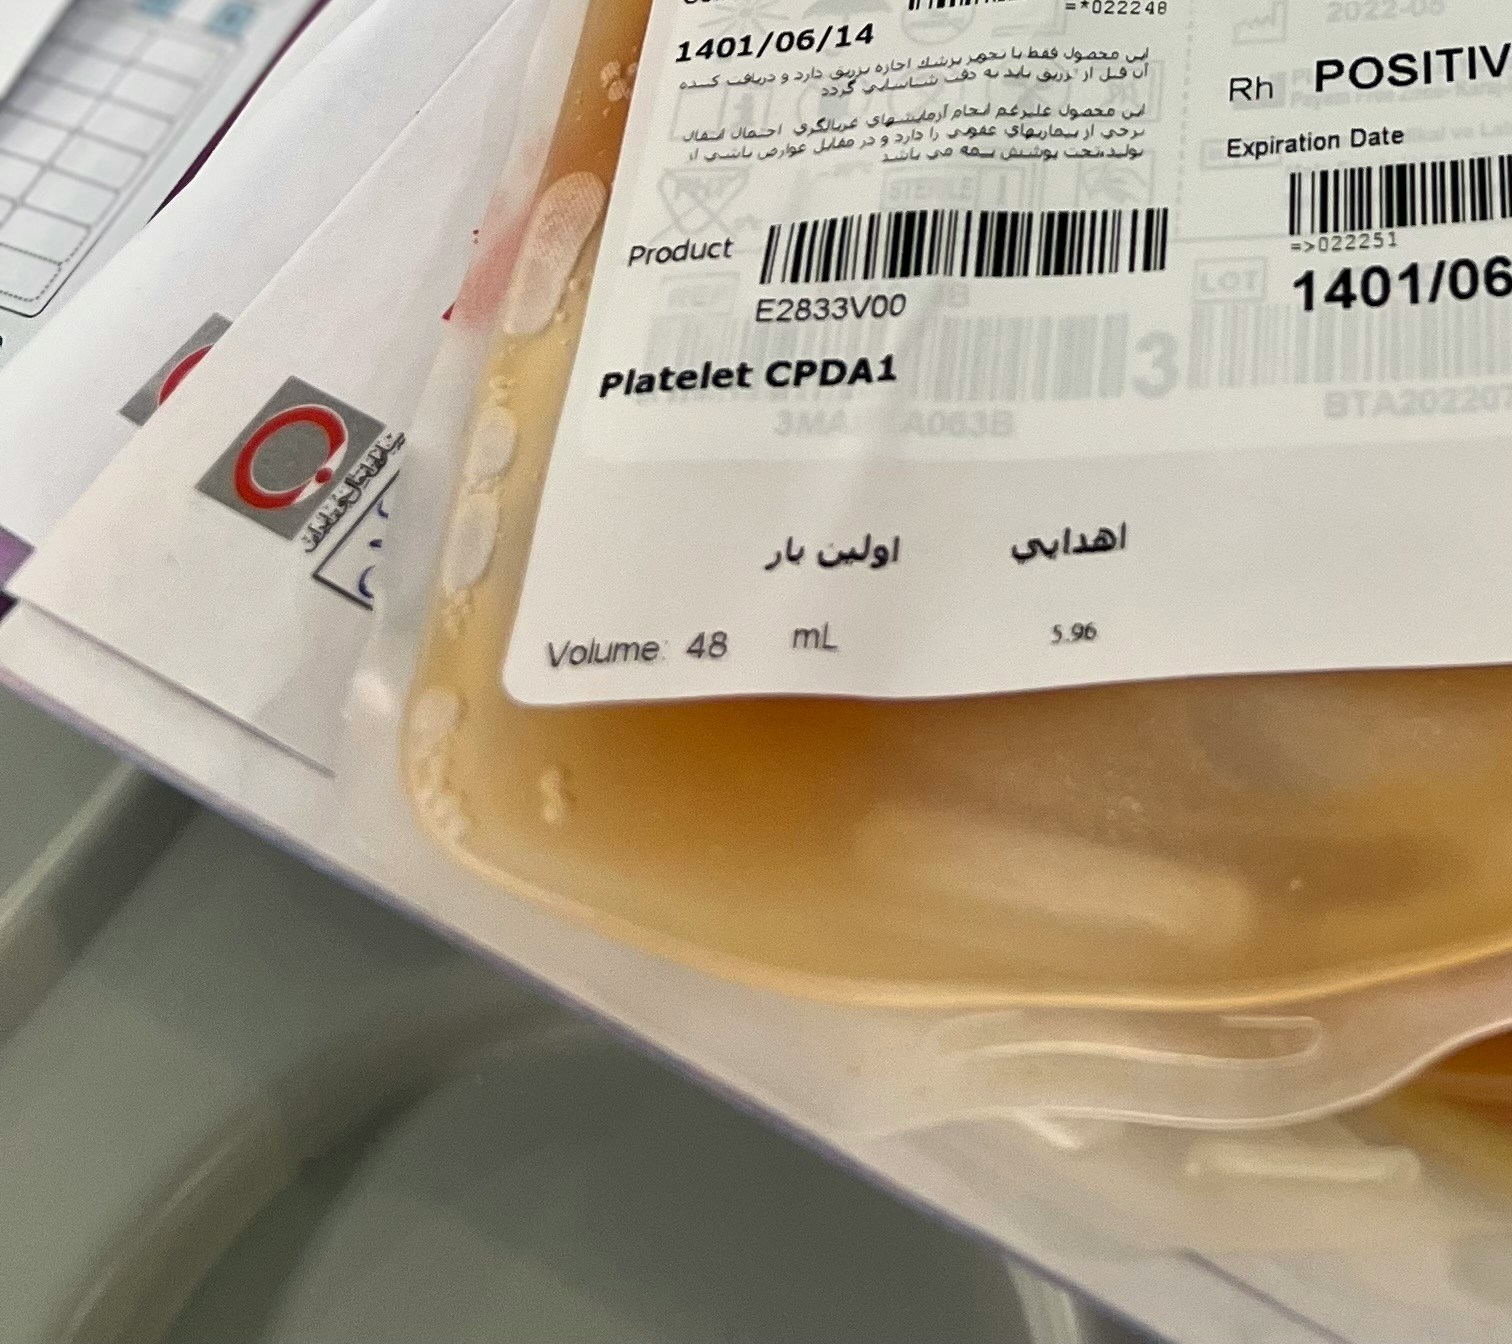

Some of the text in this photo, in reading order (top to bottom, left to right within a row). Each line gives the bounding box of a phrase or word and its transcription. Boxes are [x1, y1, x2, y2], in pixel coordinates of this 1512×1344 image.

[675, 23, 875, 63] 1401/06/14
[1228, 74, 1275, 103] Rh
[1226, 129, 1341, 161] Expiration
[1349, 123, 1405, 150] Date
[626, 237, 735, 268] Product
[755, 292, 908, 324] E2833V00
[600, 353, 898, 398] Platelet CPDA1
[764, 536, 805, 570] بار
[816, 533, 901, 570] اولین
[685, 629, 729, 660] 48
[792, 621, 839, 652] mL
